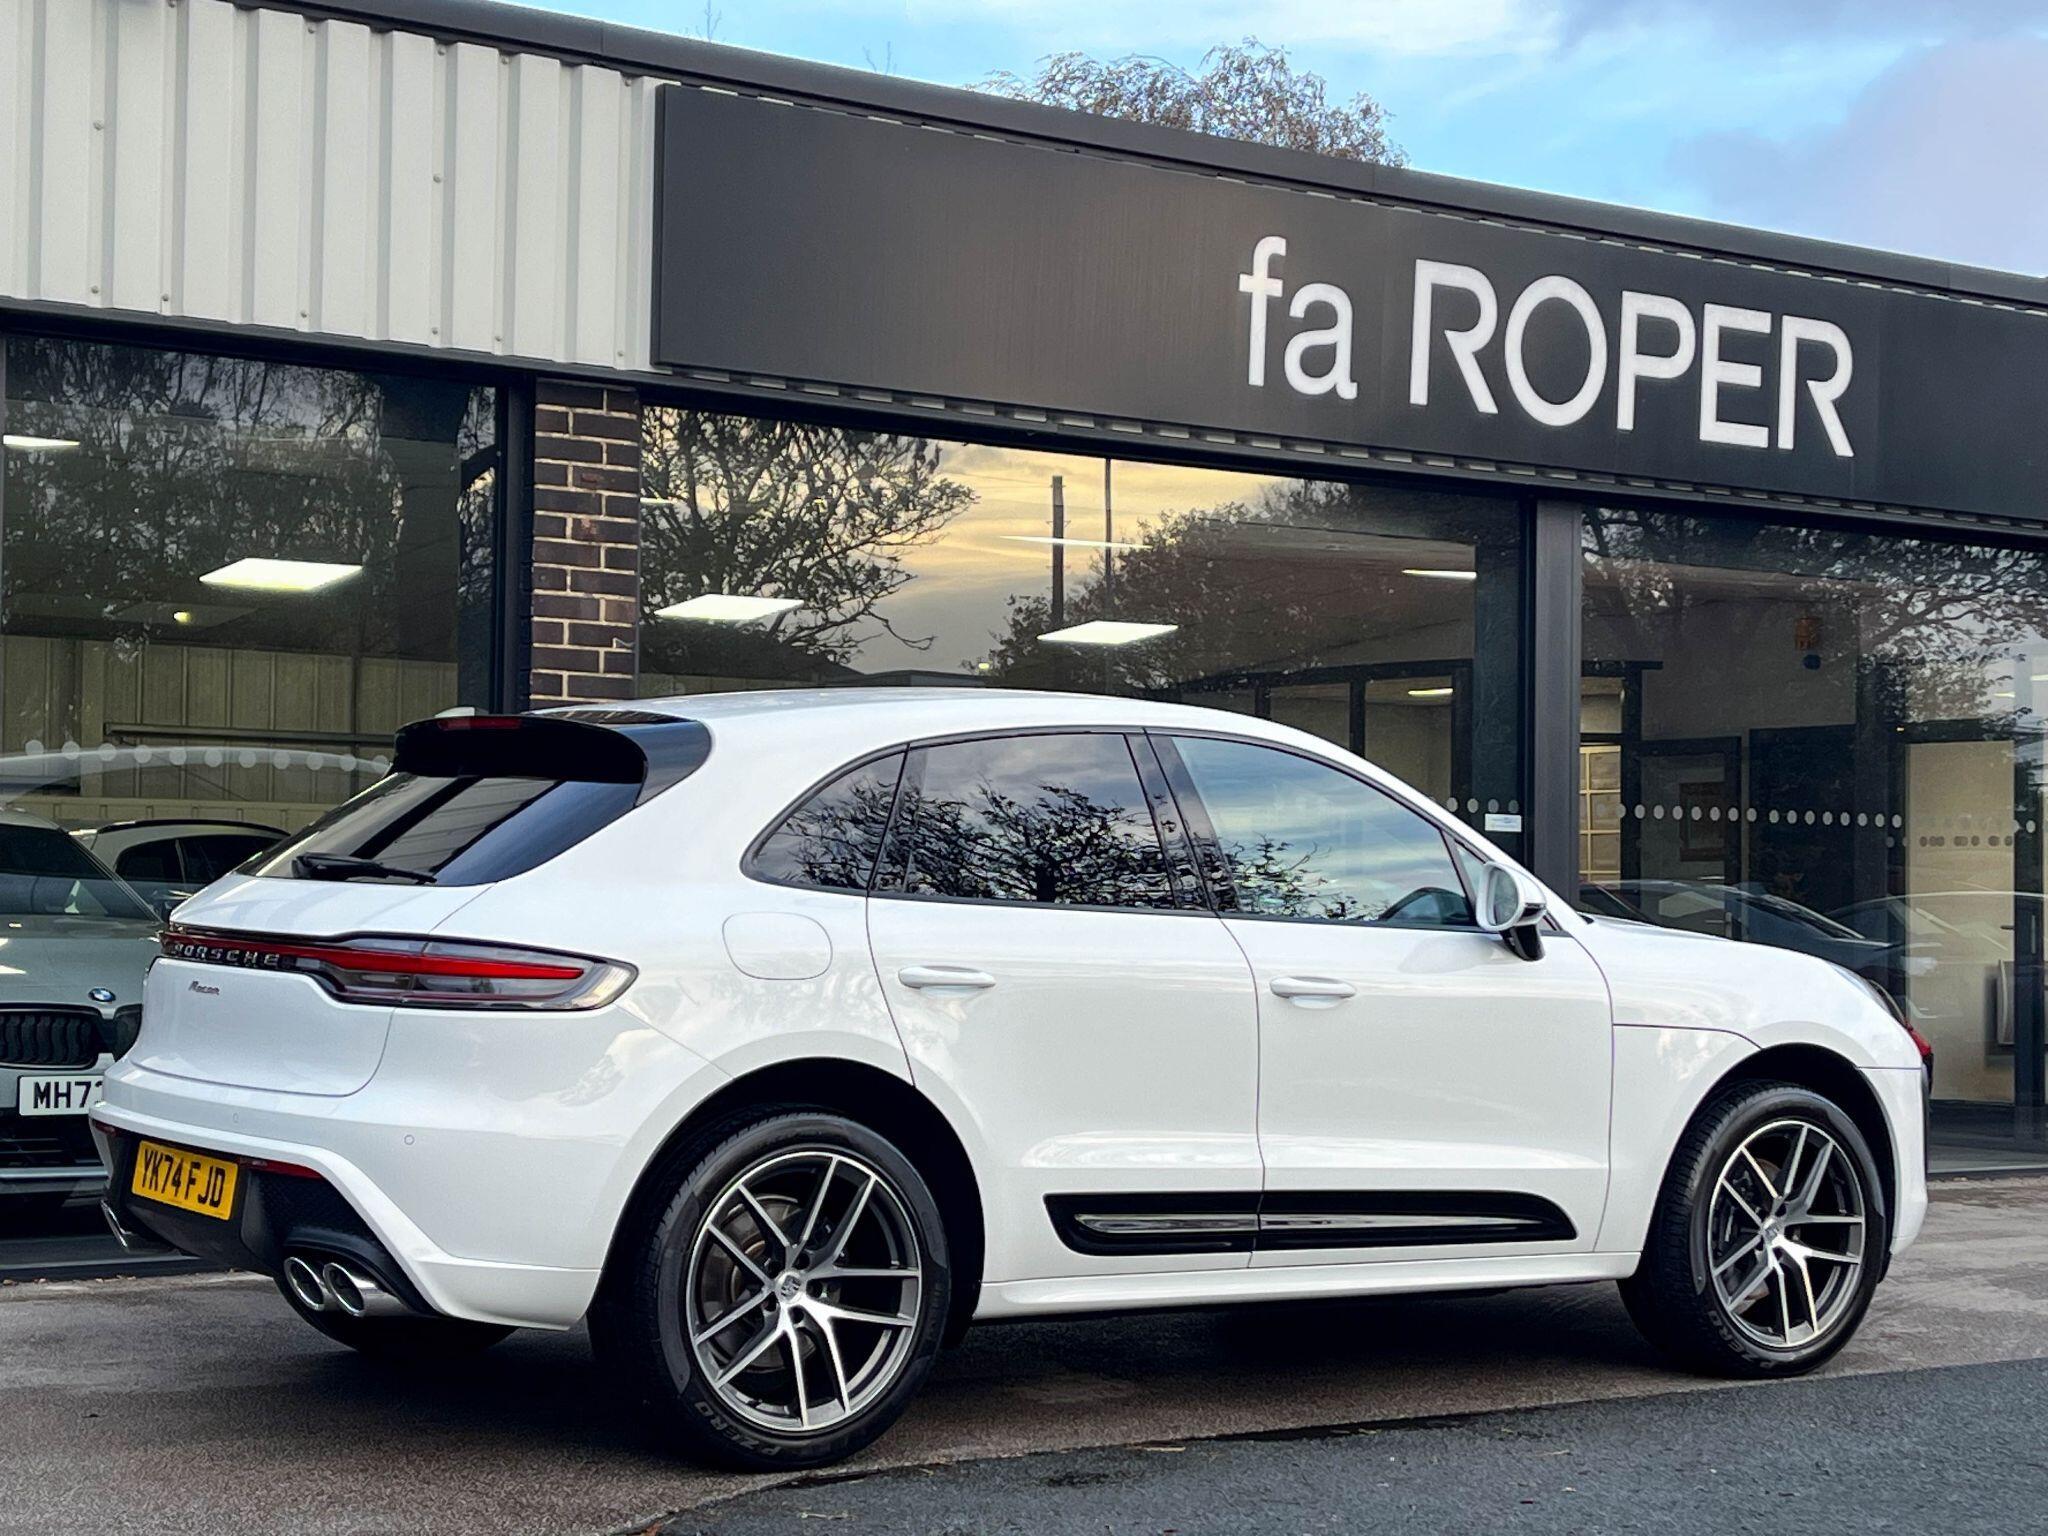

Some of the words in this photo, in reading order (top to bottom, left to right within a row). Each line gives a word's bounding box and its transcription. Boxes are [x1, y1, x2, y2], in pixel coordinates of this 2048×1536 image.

[1239, 236, 1357, 399] fa
[1410, 259, 1854, 457] ROPER
[174, 943, 280, 966] PORSCHE
[33, 1081, 103, 1109] MH7
[142, 1148, 185, 1197] YK74
[185, 1161, 226, 1208] FJD
